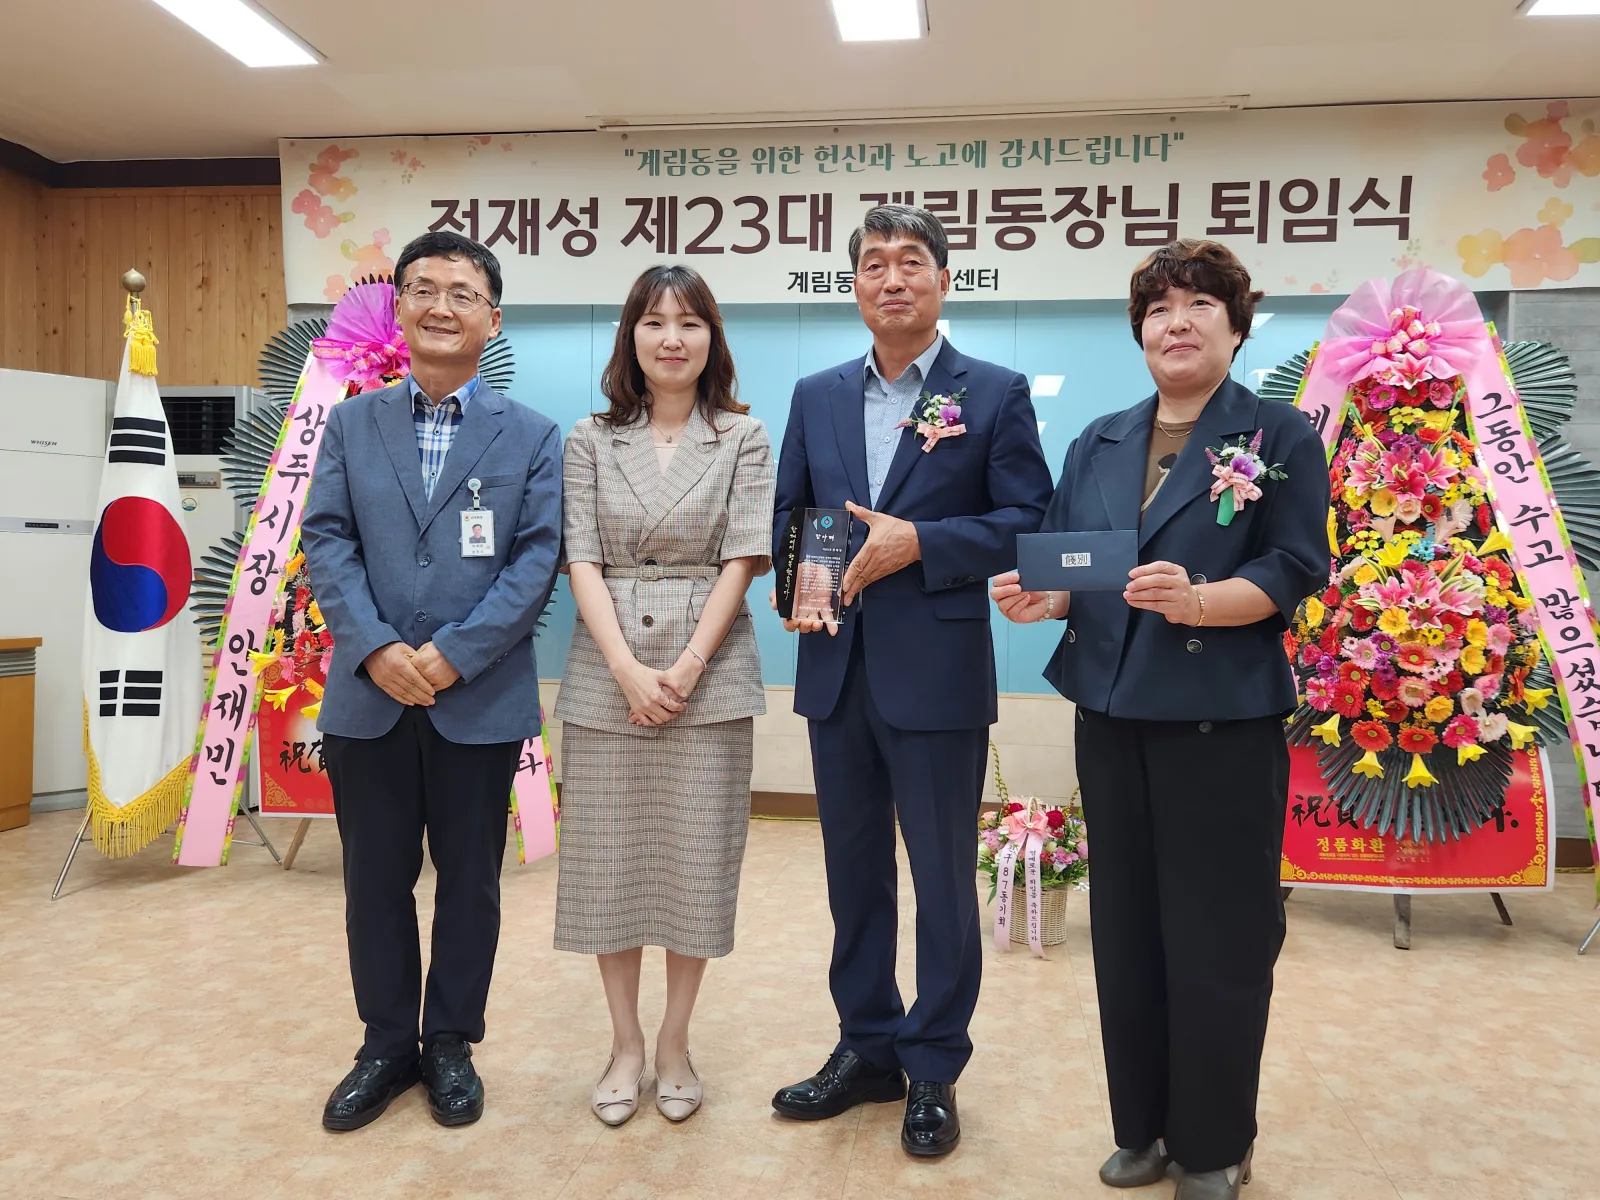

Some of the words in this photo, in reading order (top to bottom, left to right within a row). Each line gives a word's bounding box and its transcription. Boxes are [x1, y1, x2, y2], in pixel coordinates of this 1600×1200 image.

[624, 147, 741, 177] "계림동을
[750, 146, 803, 175] 위한
[813, 142, 895, 173] 헌신과
[903, 137, 988, 169] 노고에
[998, 132, 1185, 167] 감사드립니다"
[620, 193, 833, 254] 제23대
[1206, 175, 1414, 245] 퇴임식
[244, 403, 327, 596] 상주시장
[1475, 392, 1535, 484] 그동안
[1509, 504, 1565, 569] 수고
[205, 628, 260, 786] 안재민
[1316, 837, 1386, 853] 정품화환
